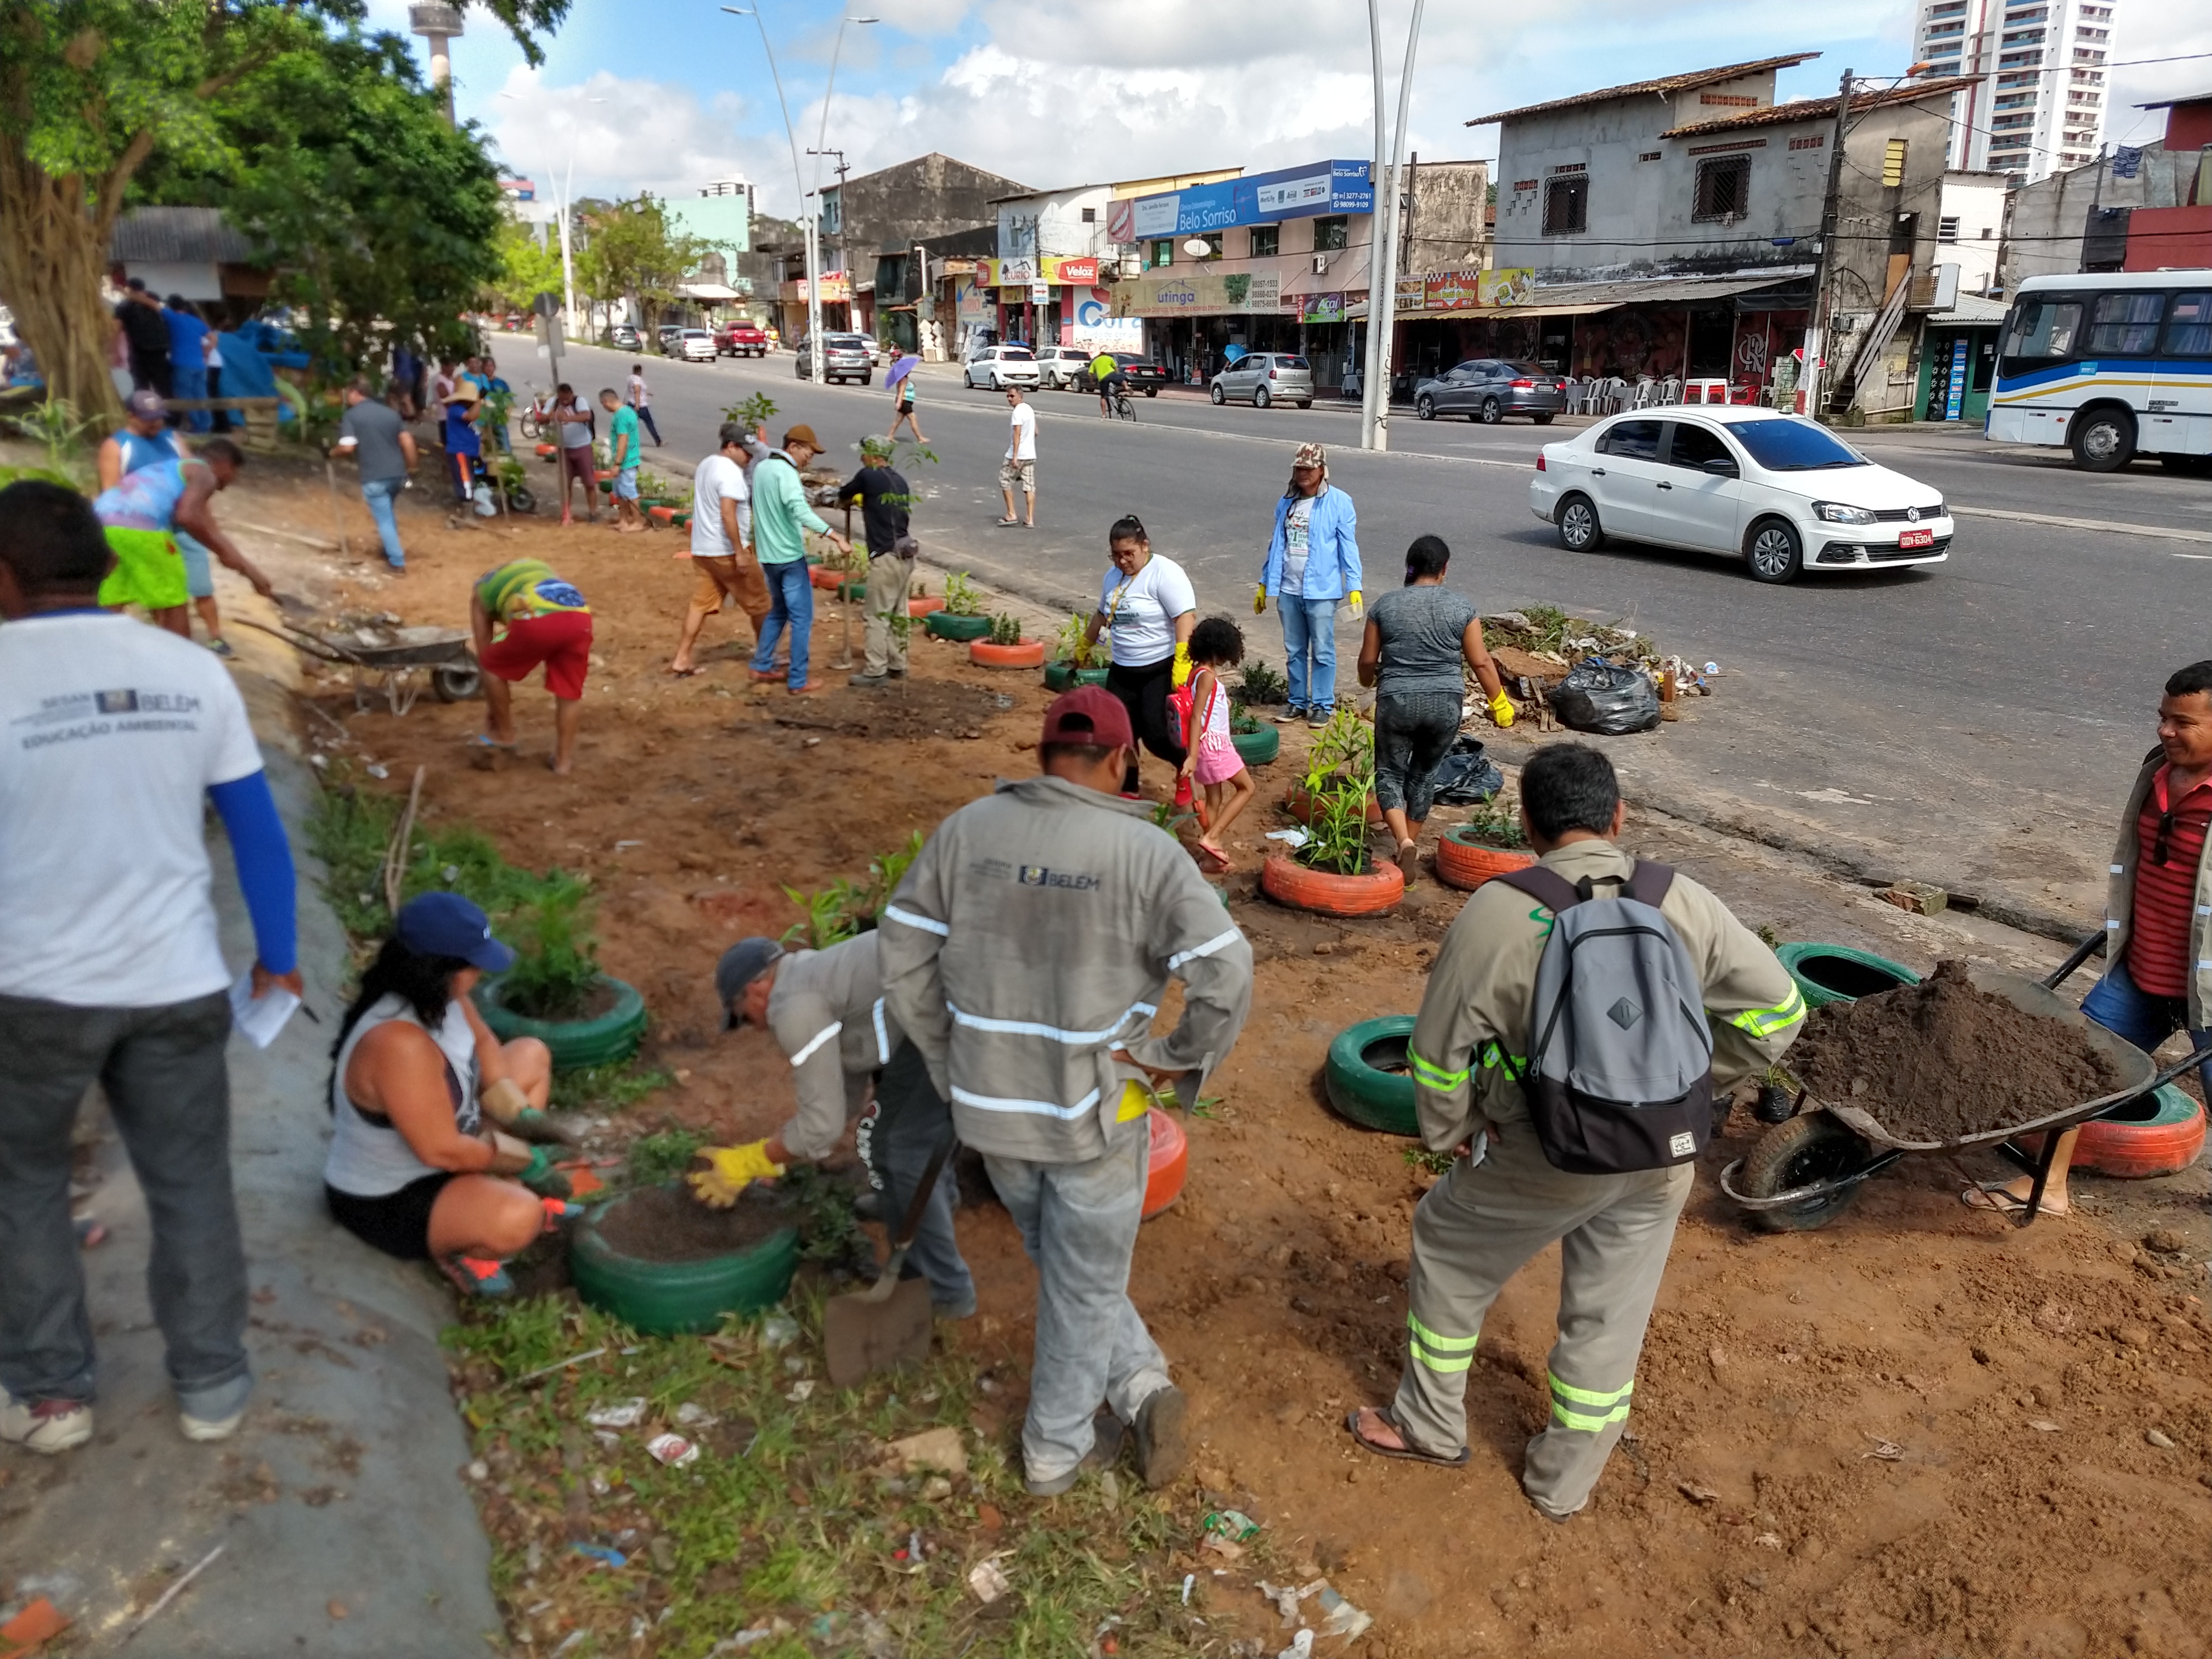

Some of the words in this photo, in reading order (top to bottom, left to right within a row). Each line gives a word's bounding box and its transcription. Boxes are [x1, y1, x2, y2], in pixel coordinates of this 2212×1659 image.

[1180, 211, 1200, 231] Belo
[1202, 207, 1236, 228] Sorriso
[1066, 265, 1094, 276] Veloz
[1252, 280, 1278, 288] 98057-1533
[1158, 291, 1194, 305] utinga
